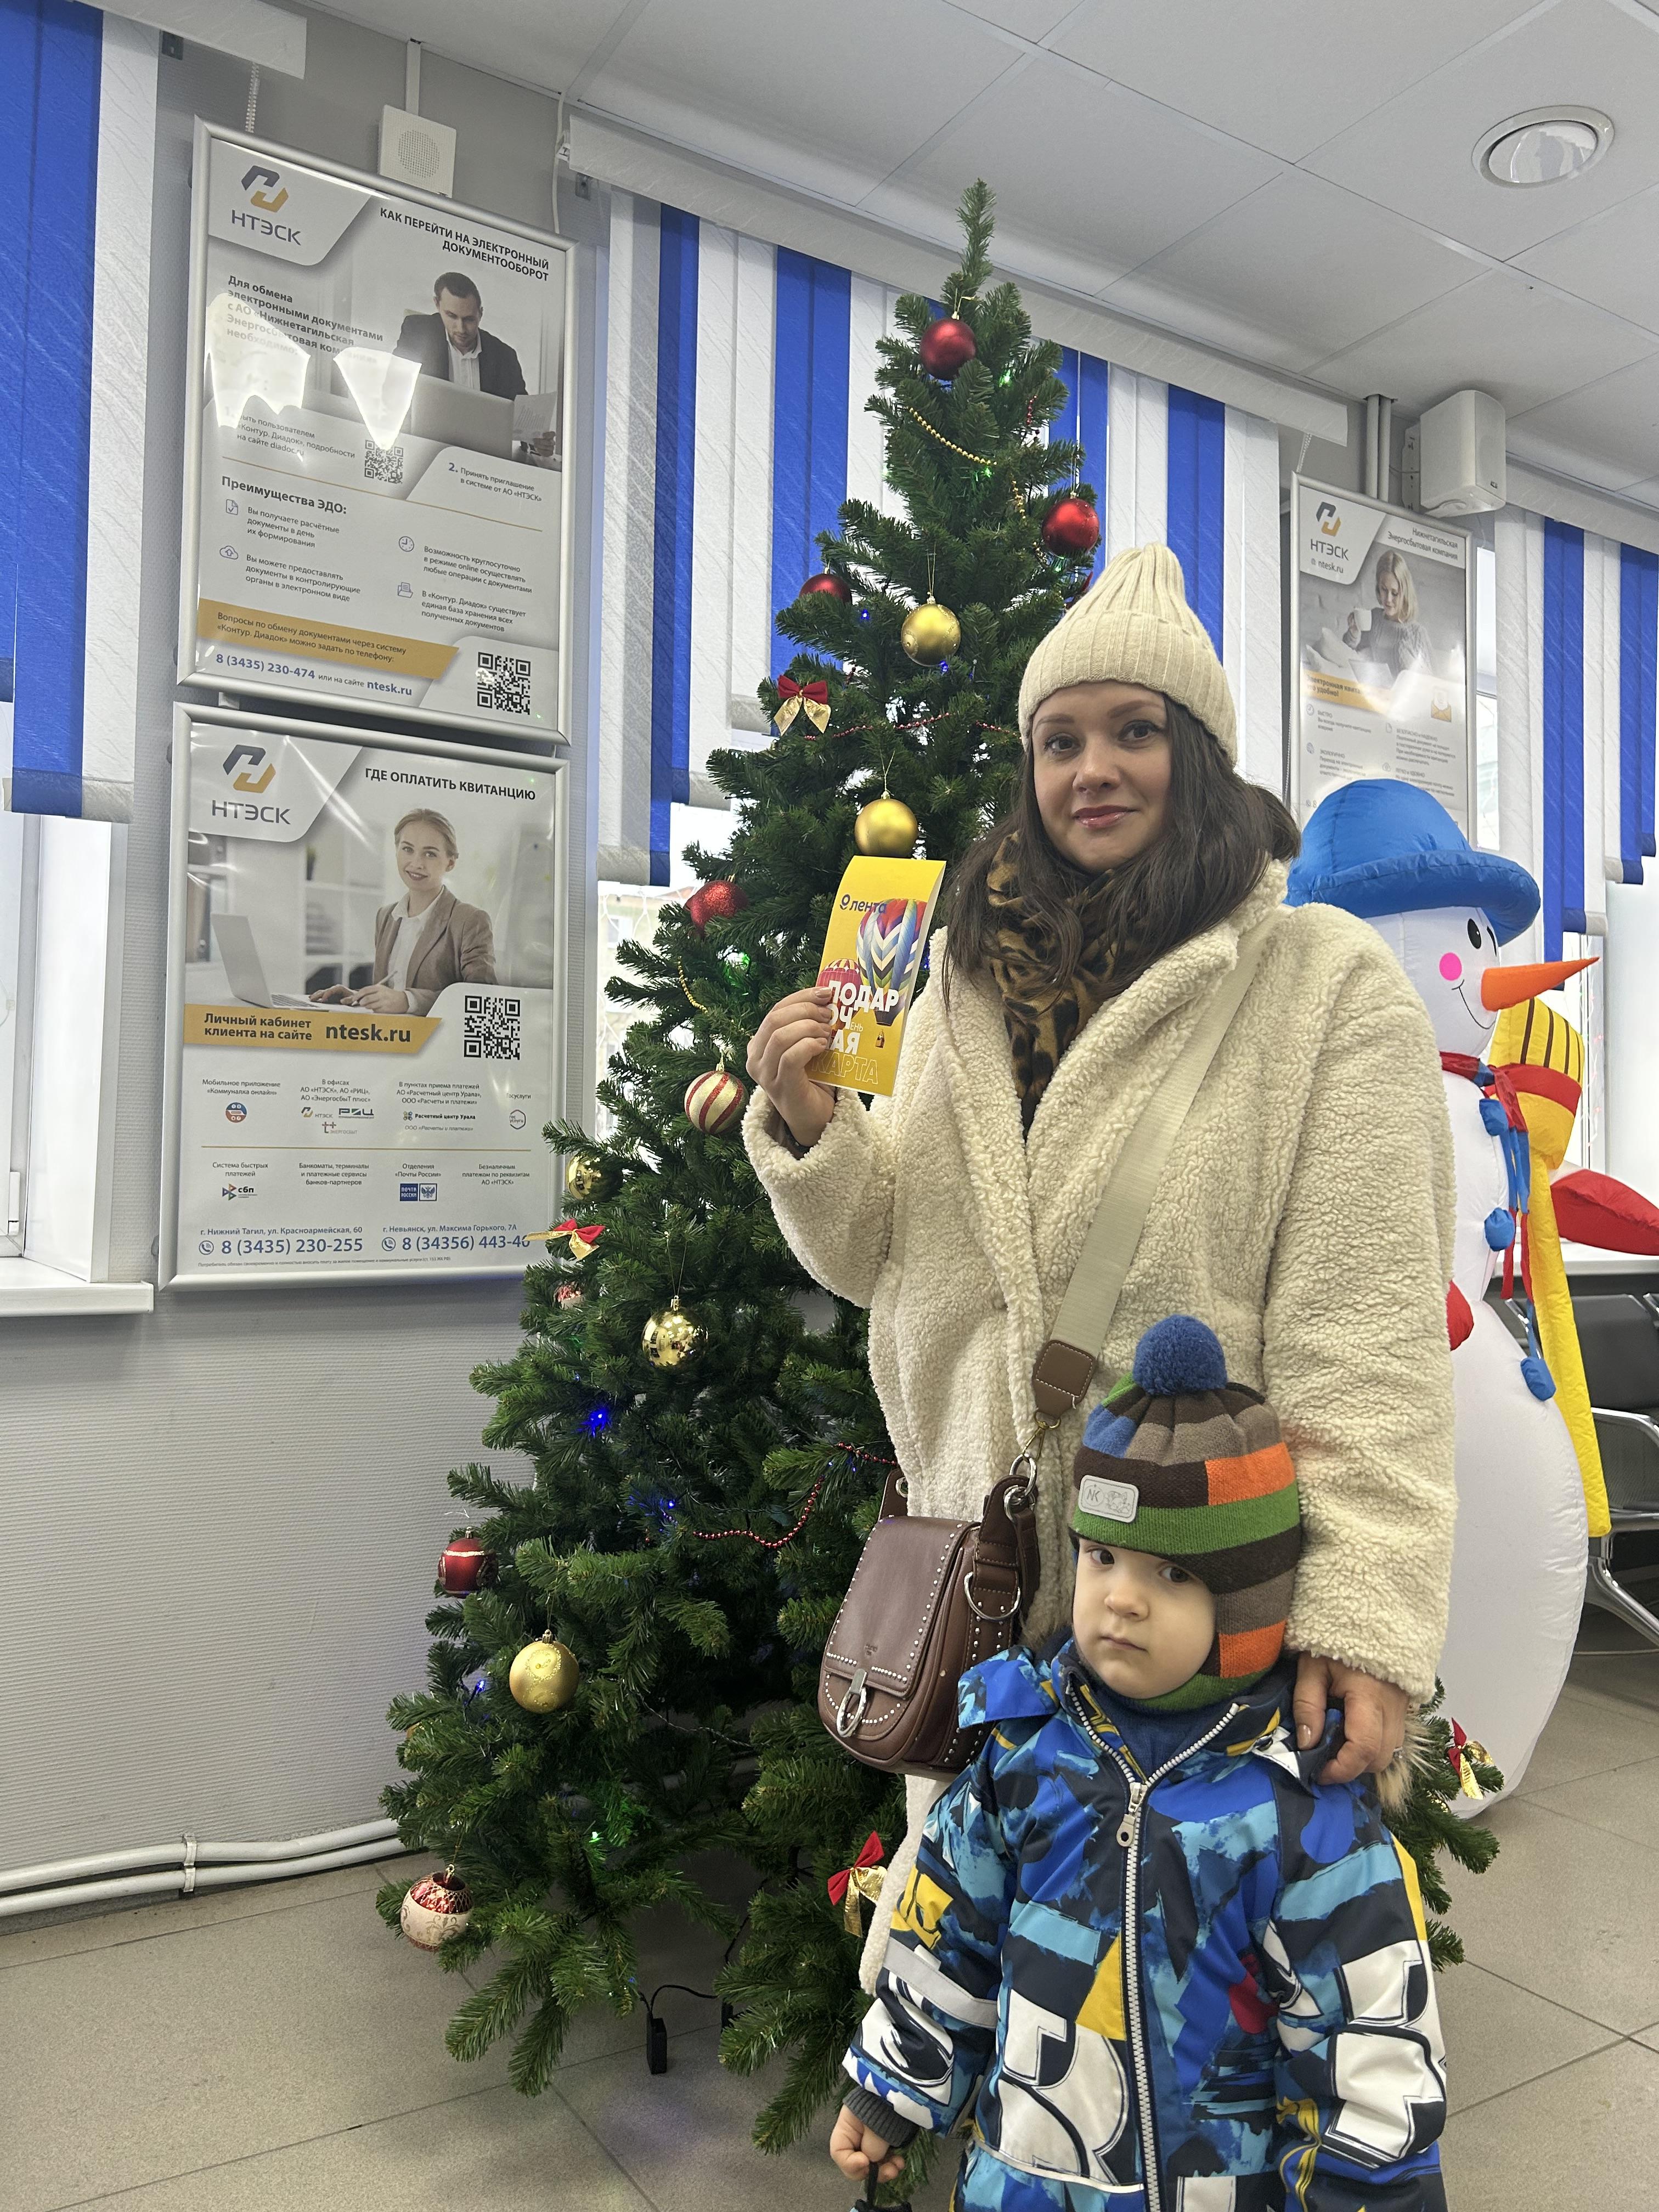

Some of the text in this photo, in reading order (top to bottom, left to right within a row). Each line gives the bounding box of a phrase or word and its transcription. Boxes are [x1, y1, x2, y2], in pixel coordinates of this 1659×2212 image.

[232, 209, 301, 245] НТЭСК
[381, 207, 549, 270] КАК ПЕРЕЙТИ НА ЭЛЕКТРОННЫЙ
[442, 240, 549, 281] ДОКУМЕНТООБОРОТ
[228, 275, 292, 303] Для обмена
[228, 290, 382, 341] электронными документами
[248, 437, 269, 447] сайте
[271, 432, 304, 447] Диадок»,
[307, 442, 355, 458] подробности
[448, 462, 534, 492] 2. Принять приглашение
[466, 479, 493, 490] системе
[514, 491, 541, 501] «НТЭСК»
[222, 476, 346, 514] Преимущества ЭДО:
[247, 506, 340, 533] Вы получаете расчётные
[247, 518, 289, 532] документы
[258, 530, 315, 548] формирования
[1311, 539, 1349, 561] НТЭСК
[246, 554, 343, 580] Вы можете предоставлять
[424, 546, 520, 572] Возможность круглосуточно
[430, 558, 457, 568] режиме
[458, 564, 479, 573] online
[480, 569, 526, 583] осуществлять
[1318, 560, 1344, 573] ntesk.ru
[246, 566, 287, 579] документы
[296, 577, 360, 594] контролирующие
[246, 576, 273, 586] органы
[281, 584, 331, 597] электронном
[332, 594, 350, 602] виде
[424, 566, 447, 575] любые
[448, 572, 482, 583] операции
[488, 580, 532, 593] документами
[421, 601, 447, 611] единая
[448, 606, 463, 614] база
[465, 610, 496, 621] хранения
[428, 592, 458, 604] «Контур.
[458, 598, 487, 609] Диадок»
[488, 606, 527, 617] существует
[218, 612, 253, 626] Вопросы
[268, 623, 297, 635] обмену
[298, 630, 351, 644] документами
[352, 640, 375, 648] через
[376, 644, 407, 655] систему
[421, 611, 505, 632] полученных документов
[217, 624, 252, 637] «Контур.
[253, 630, 287, 642] Диадок»
[290, 638, 316, 648] можно
[318, 644, 343, 653] задать
[216, 654, 223, 663] 8
[227, 656, 264, 672] (3435)
[268, 663, 315, 679] 230-474
[367, 680, 412, 696] ntesk.ru
[366, 769, 535, 800] ГДЕ ОПЛАТИТЬ КВИТАНЦИЮ
[212, 800, 291, 825] НТЭСК
[850, 900, 887, 915] лента
[828, 980, 899, 1013] ПОДАР
[204, 1013, 312, 1030] Личный кабинет
[205, 1028, 312, 1040] клиента на сайте
[325, 1023, 411, 1042] ntesk.ru
[811, 1051, 878, 1085] КАРТА
[281, 1227, 351, 1235] Красноармейская,
[402, 1237, 411, 1250] 8
[416, 1235, 474, 1252] (34356)
[221, 1238, 363, 1255] 8 (3435) 230-255
